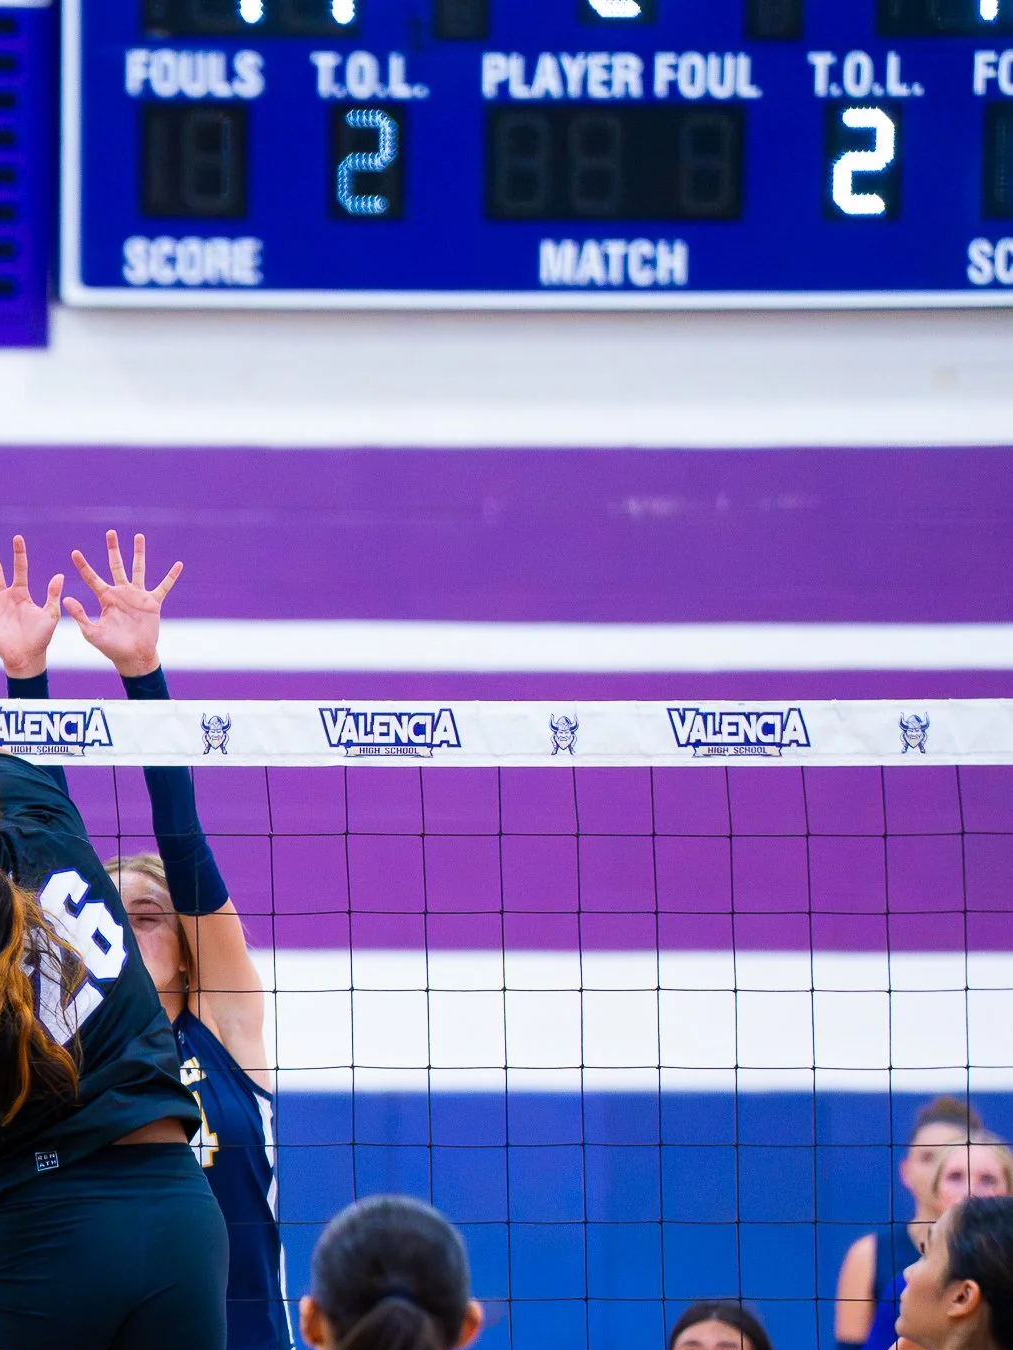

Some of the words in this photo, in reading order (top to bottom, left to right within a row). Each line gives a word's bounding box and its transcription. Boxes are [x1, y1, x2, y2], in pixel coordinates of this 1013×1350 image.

[125, 48, 266, 98] FOULS
[309, 50, 430, 99] T.O.L.
[482, 51, 645, 99] PLAYER
[654, 51, 763, 99] FOUL
[807, 50, 925, 98] T.O.L.
[338, 109, 398, 215] 2
[832, 106, 895, 215] 2
[122, 236, 264, 286] SCORE
[540, 238, 688, 287] MATCH
[318, 708, 461, 747] VALENCIA
[666, 708, 810, 747] VALENCIA
[707, 746, 729, 754] HIGH
[734, 746, 768, 754] SCHOOL
